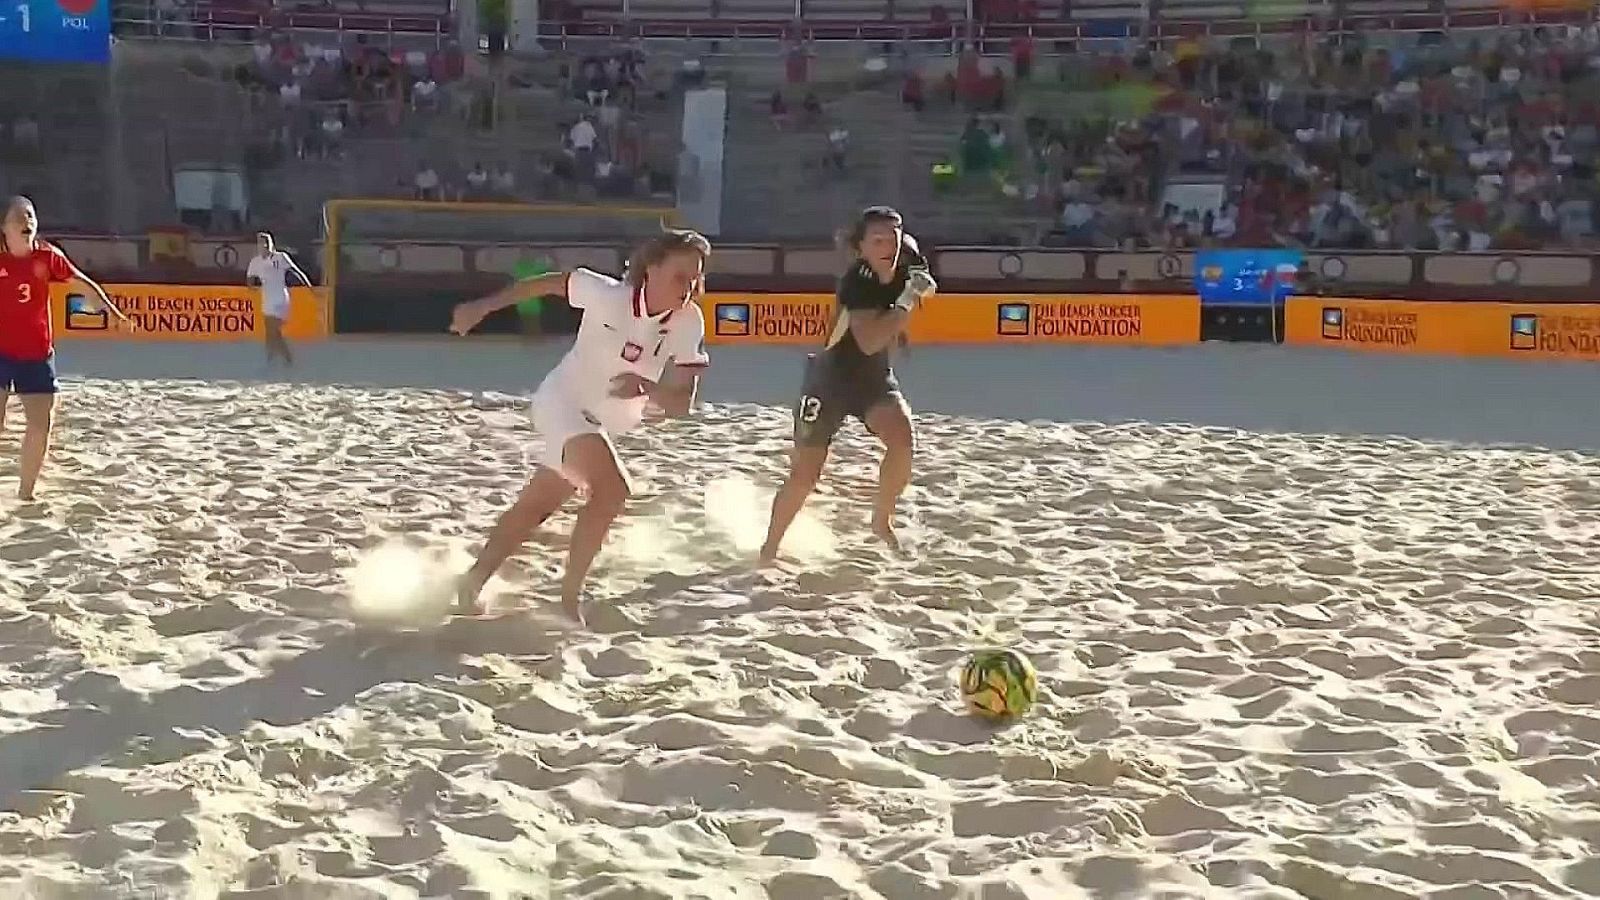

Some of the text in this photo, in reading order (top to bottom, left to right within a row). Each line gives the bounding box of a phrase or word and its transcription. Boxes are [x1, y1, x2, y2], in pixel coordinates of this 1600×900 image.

[17, 4, 30, 32] 1
[62, 17, 89, 30] POL
[18, 283, 31, 303] 3
[1233, 277, 1245, 291] 3
[112, 295, 253, 313] THE BEACH SOCCER
[126, 313, 254, 333] OUNDATION
[754, 319, 826, 336] FOUNDA
[1033, 319, 1141, 336] FOUNDATION
[800, 395, 822, 421] 13
